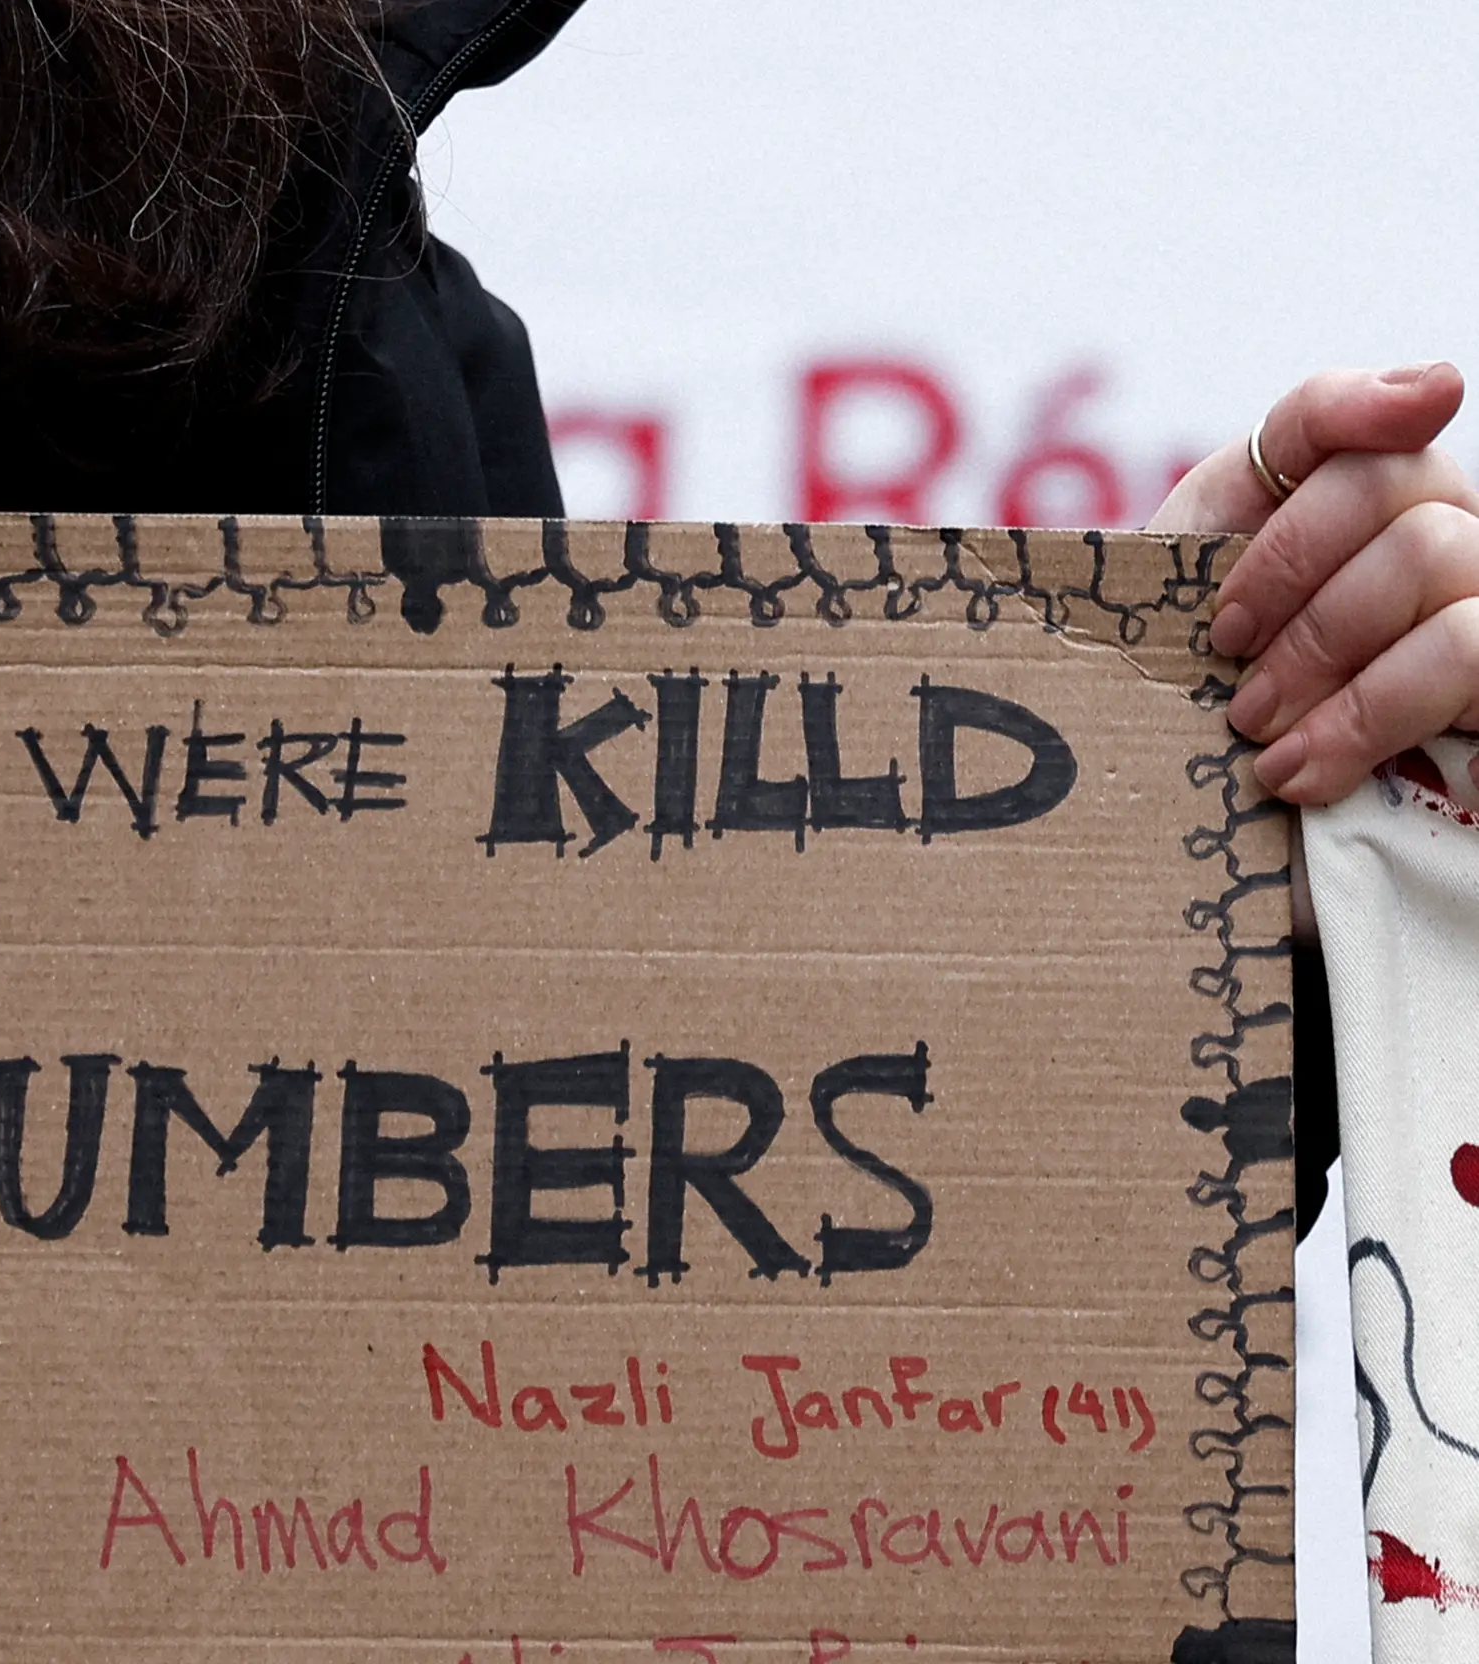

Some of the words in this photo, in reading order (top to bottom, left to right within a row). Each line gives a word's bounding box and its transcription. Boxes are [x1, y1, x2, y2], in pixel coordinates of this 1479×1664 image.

[16, 700, 406, 840] WERE
[476, 663, 1077, 861] KILLD
[424, 1341, 672, 1431] Nazli
[101, 1448, 446, 1573] Ahmad
[566, 1453, 1135, 1580] Khosravani
